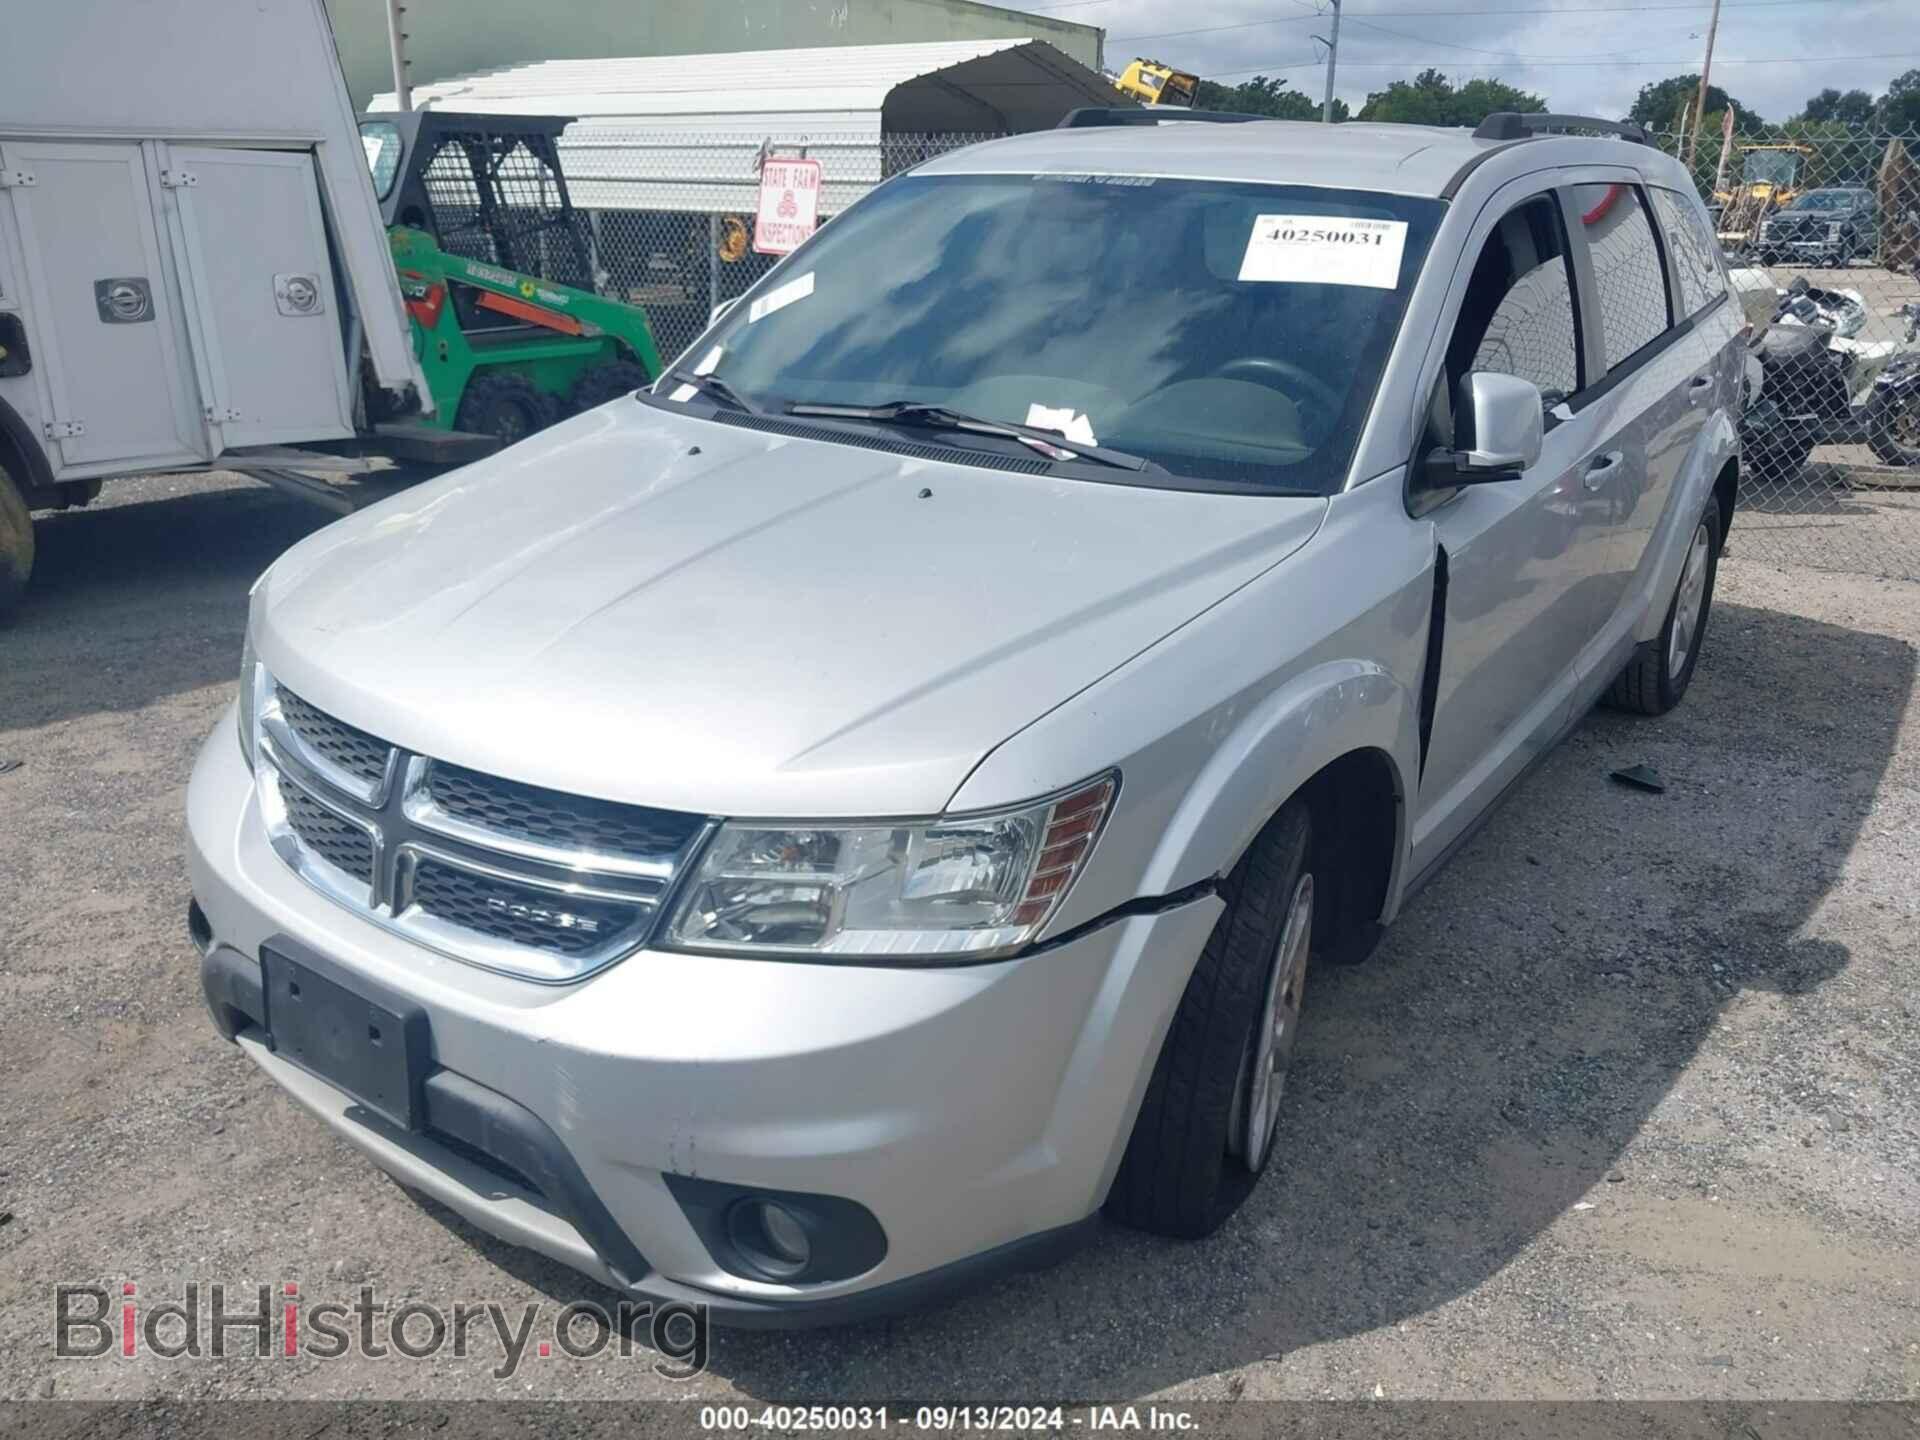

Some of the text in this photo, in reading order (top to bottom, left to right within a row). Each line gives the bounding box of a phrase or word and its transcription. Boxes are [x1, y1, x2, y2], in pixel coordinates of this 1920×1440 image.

[764, 167, 817, 190] STATE FARM
[1266, 228, 1383, 246] 40250031
